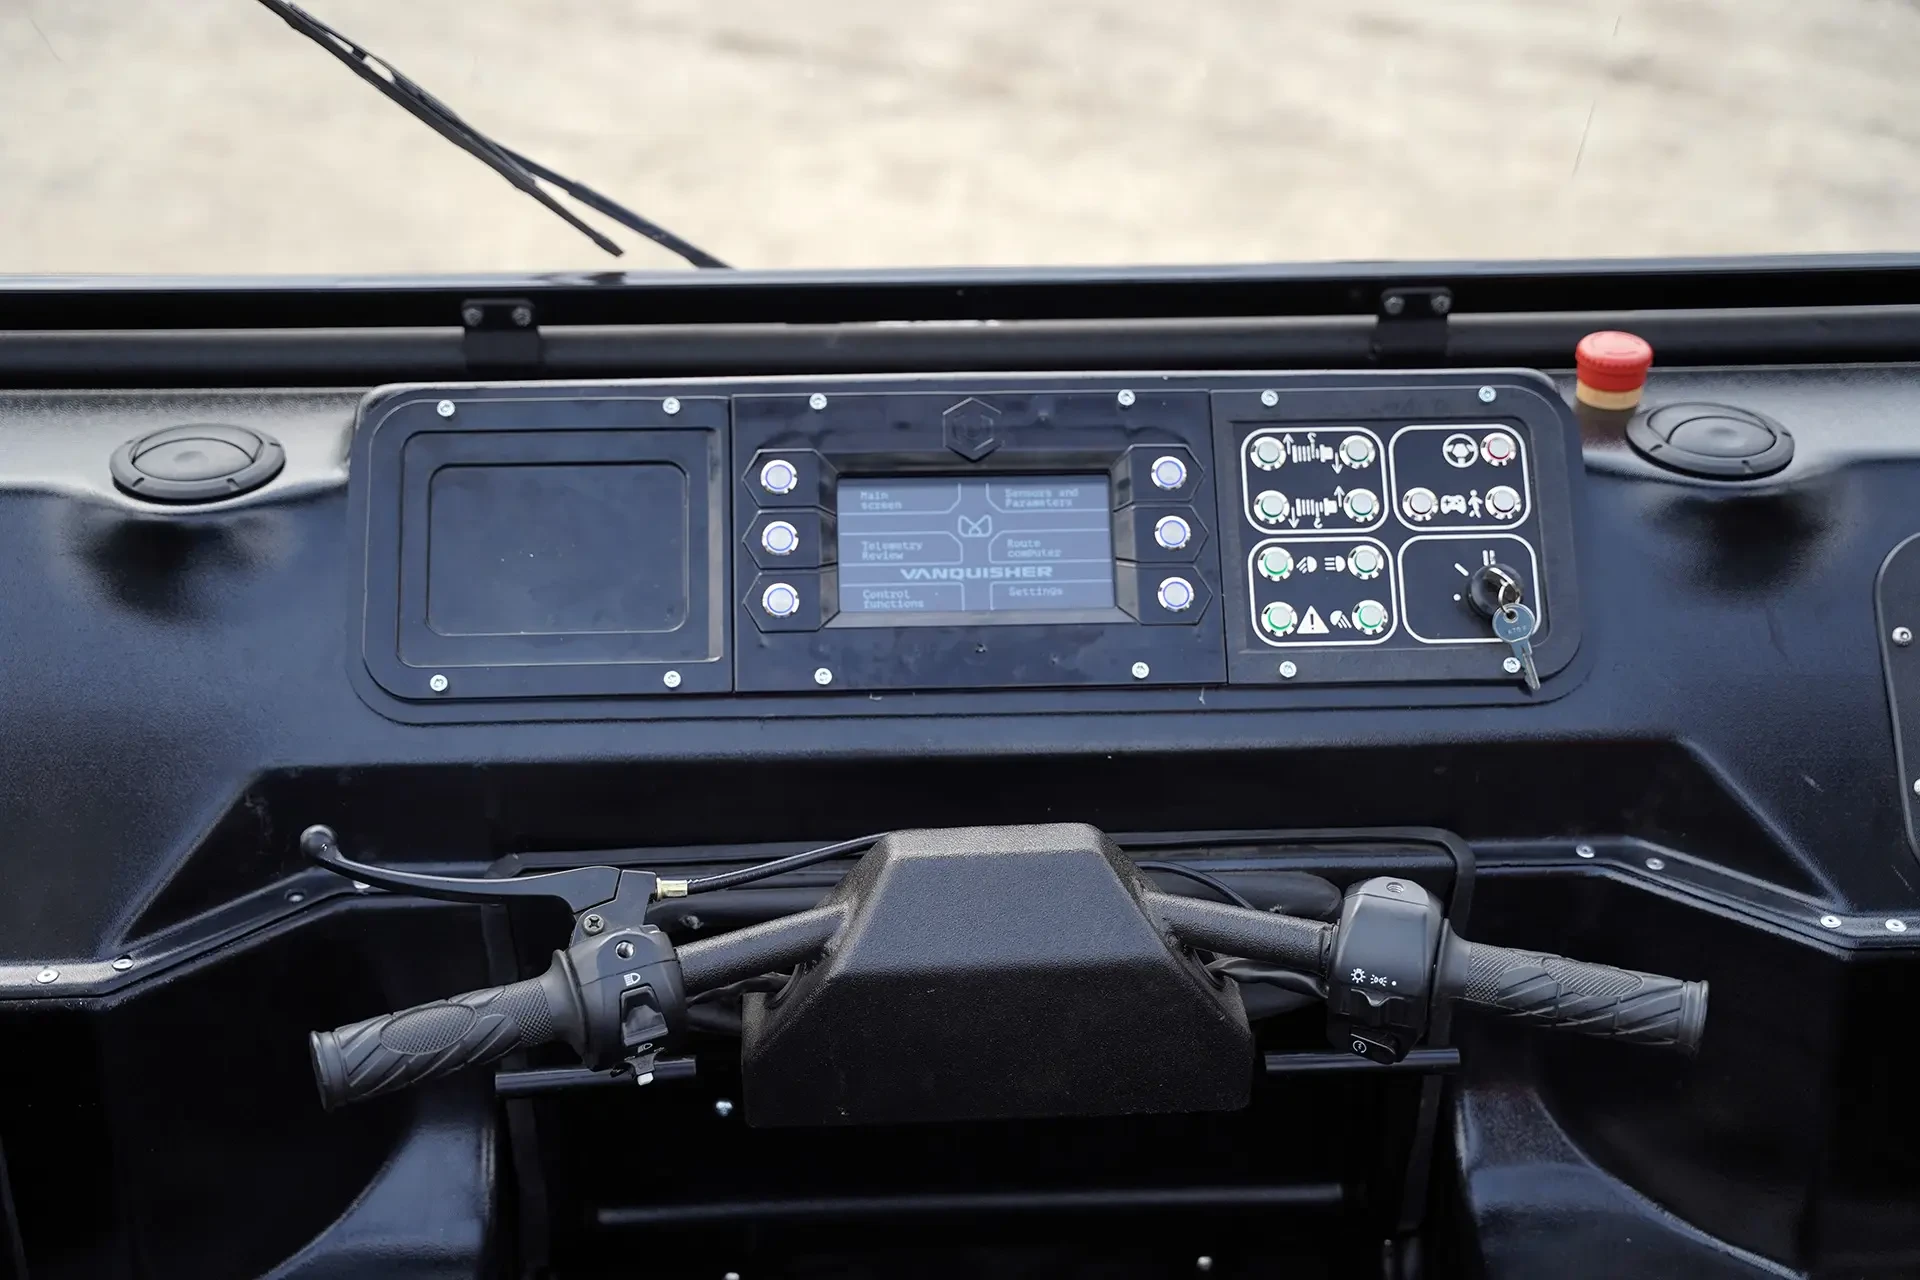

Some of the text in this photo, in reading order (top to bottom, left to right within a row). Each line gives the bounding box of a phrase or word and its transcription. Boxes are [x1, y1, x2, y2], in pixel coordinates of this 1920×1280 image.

[860, 490, 889, 500] Main
[1005, 488, 1079, 498] Sensors and
[861, 500, 903, 510] screen
[1005, 498, 1073, 508] Parameters
[861, 540, 923, 551] Telemetry
[1007, 538, 1042, 548] Route
[862, 551, 904, 560] Review
[1007, 548, 1062, 558] computer
[900, 566, 1053, 580] VANQUISHER
[863, 588, 910, 599] Control
[1009, 586, 1063, 597] Settings
[863, 599, 924, 609] functions
